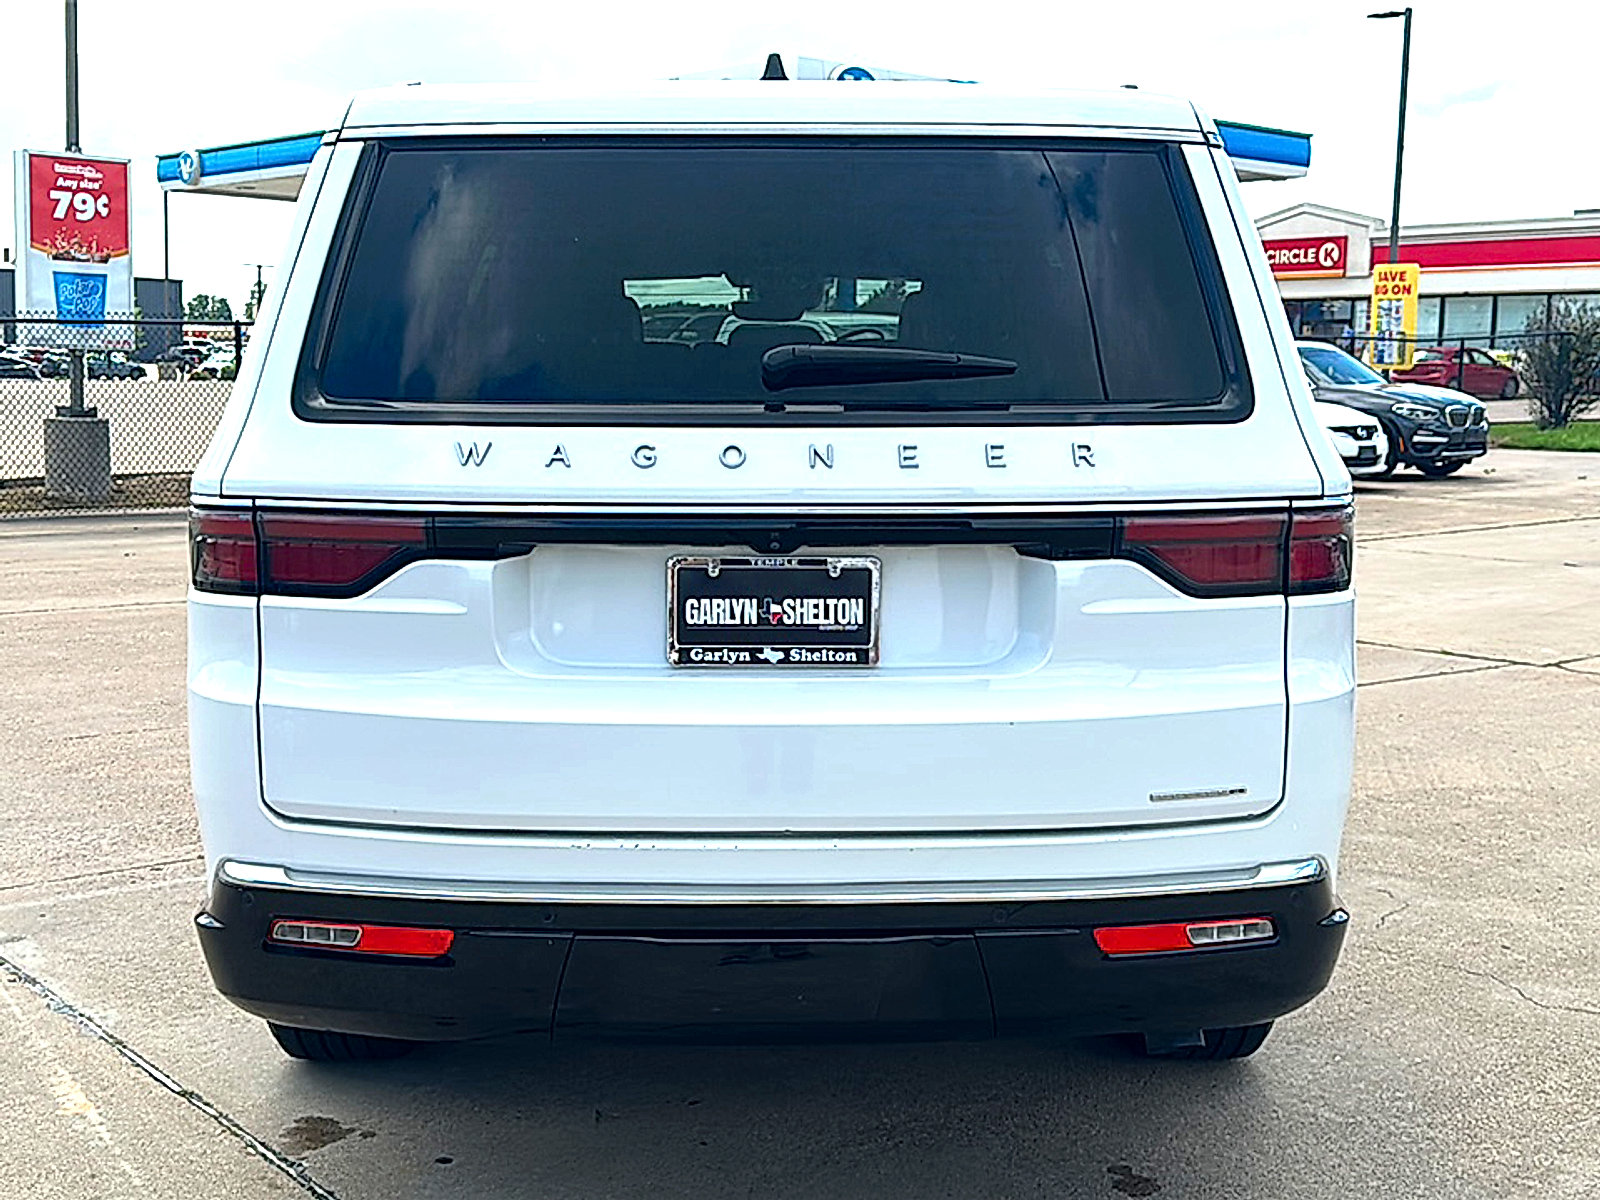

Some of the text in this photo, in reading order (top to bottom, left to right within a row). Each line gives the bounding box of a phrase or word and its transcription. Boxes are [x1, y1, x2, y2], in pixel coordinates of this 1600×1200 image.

[50, 190, 109, 221] 79¢
[1267, 248, 1317, 264] CIRCLE
[1391, 283, 1412, 295] ON
[454, 441, 1097, 469] WAGONEER
[685, 598, 864, 625] GARLYN SHELTON
[690, 648, 857, 664] Garlyn Shelton
